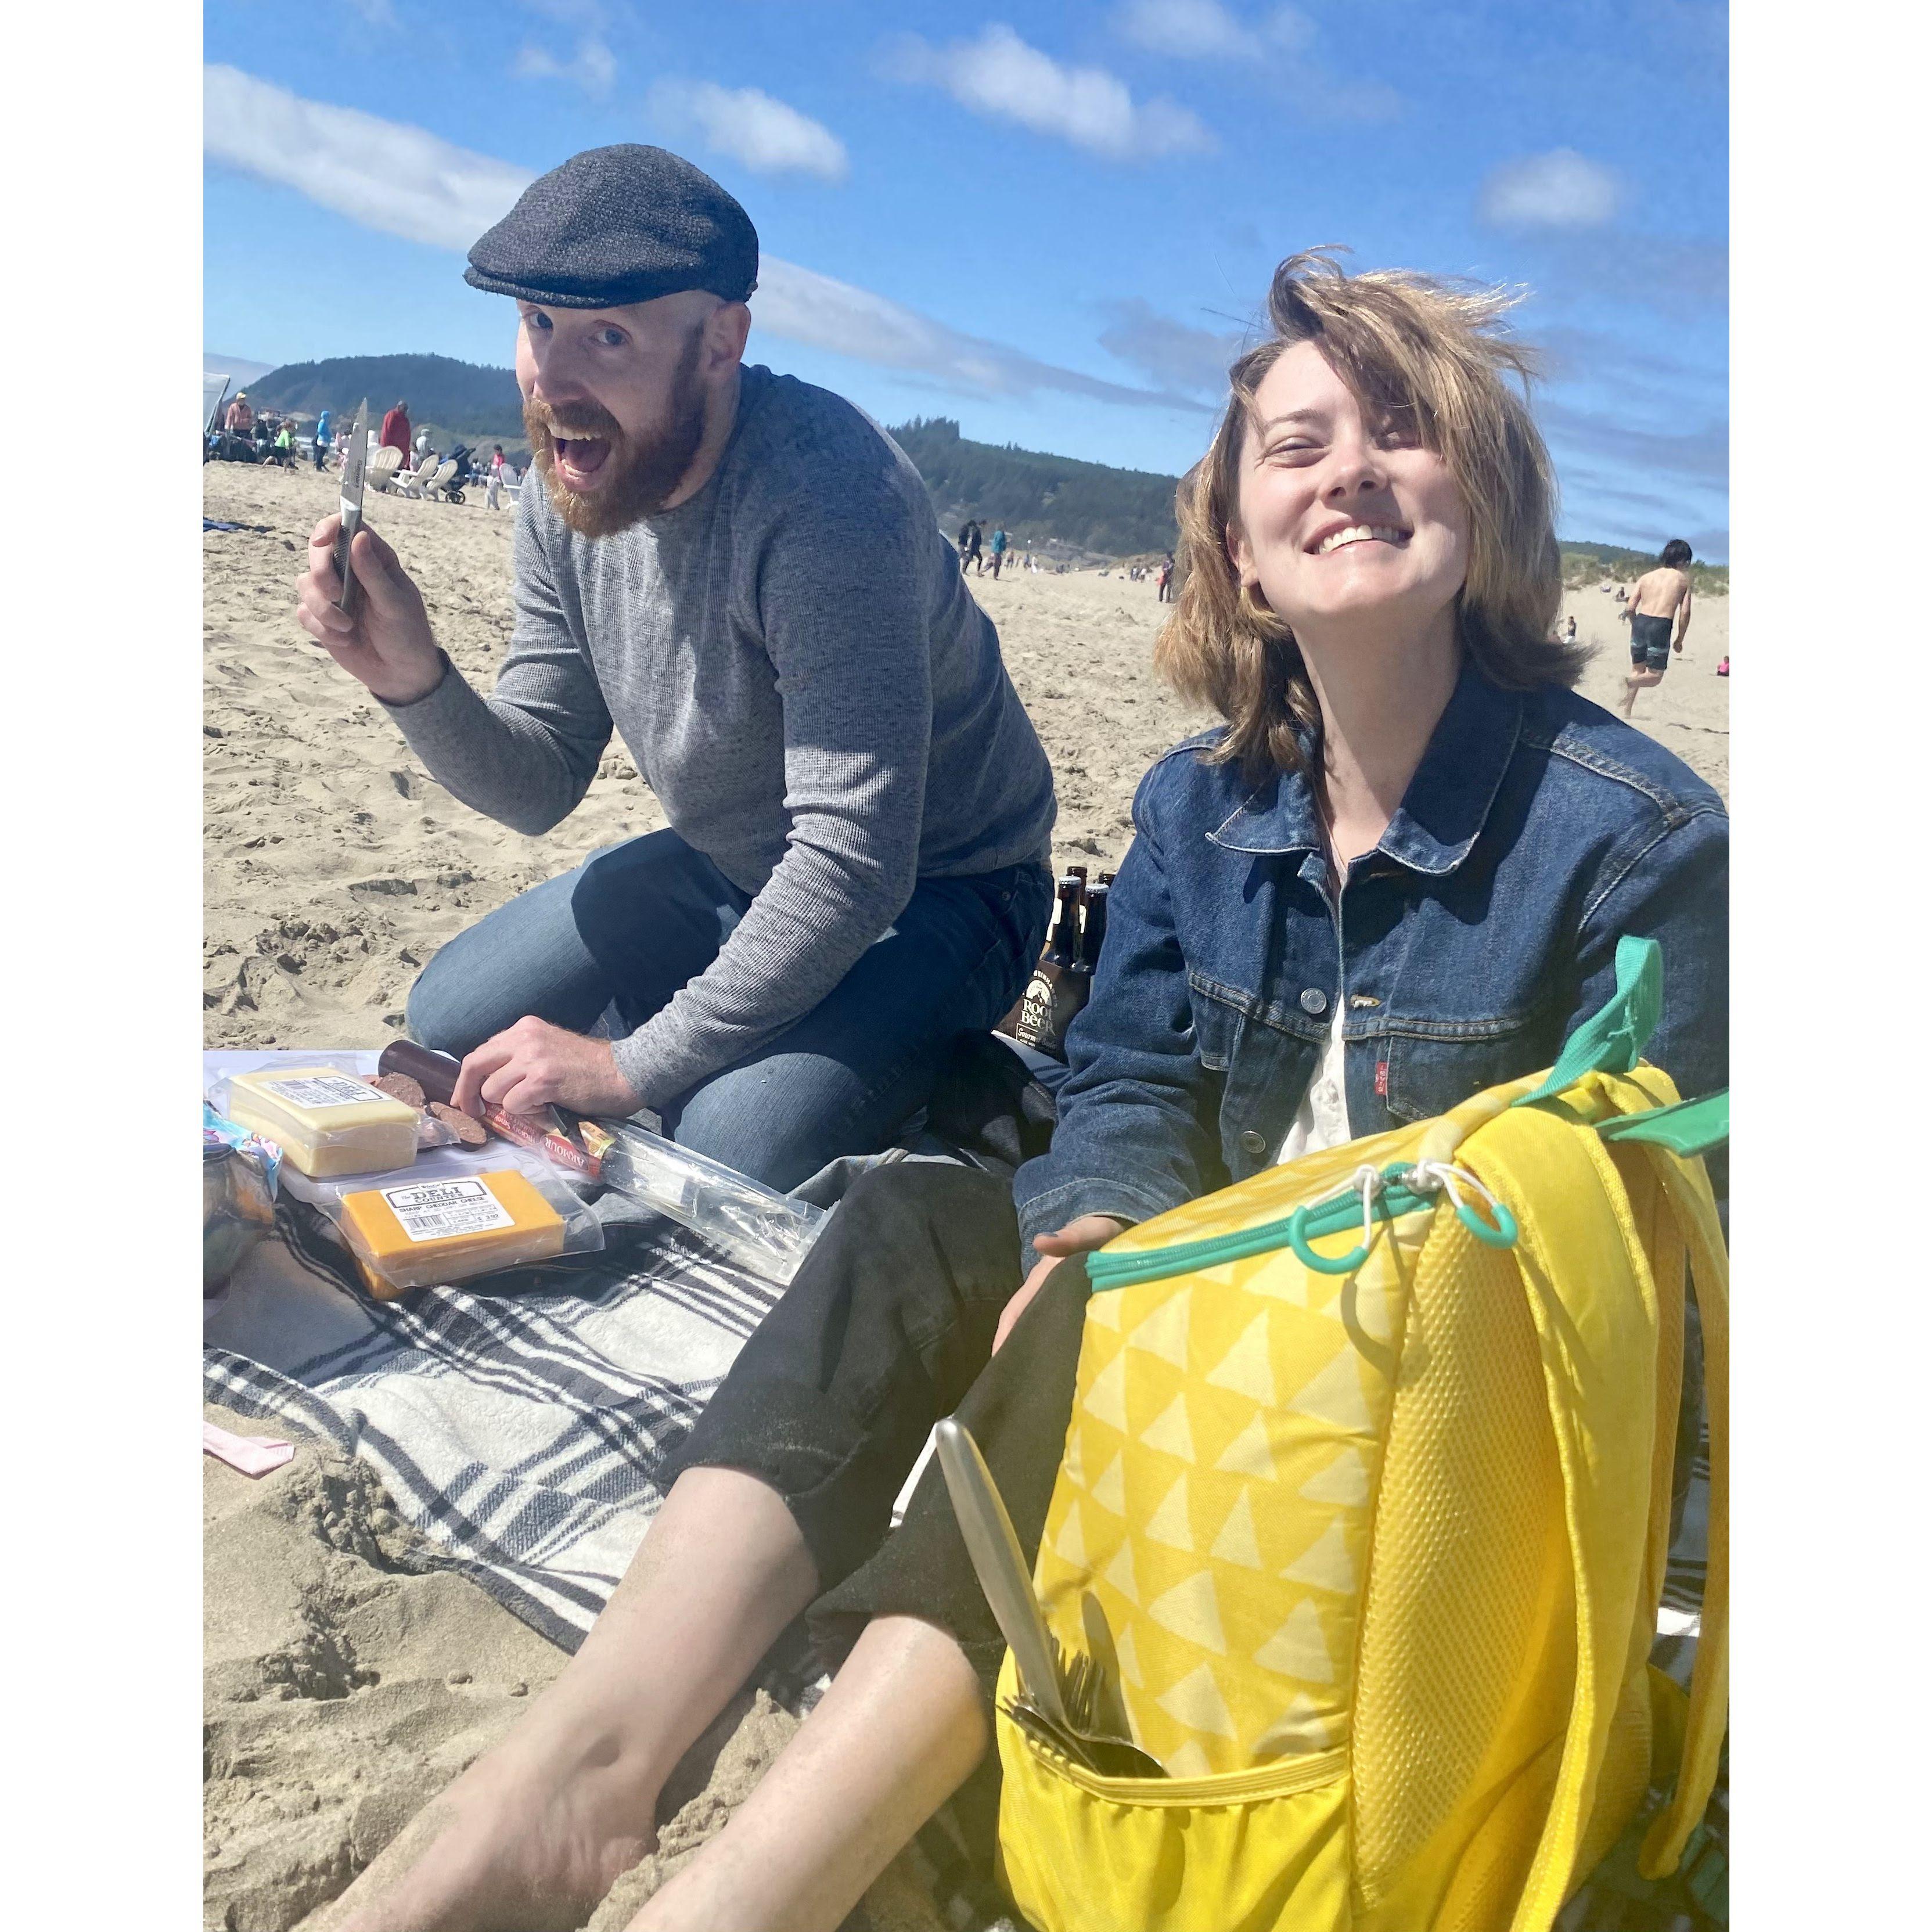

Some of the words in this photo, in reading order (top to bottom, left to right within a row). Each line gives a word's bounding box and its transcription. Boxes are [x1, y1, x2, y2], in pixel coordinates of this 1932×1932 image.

[545, 1136, 585, 1167] ARMOUR
[410, 1187, 462, 1200] DELI
[415, 1193, 463, 1203] COUNTER
[426, 1200, 458, 1209] CHEDDAR
